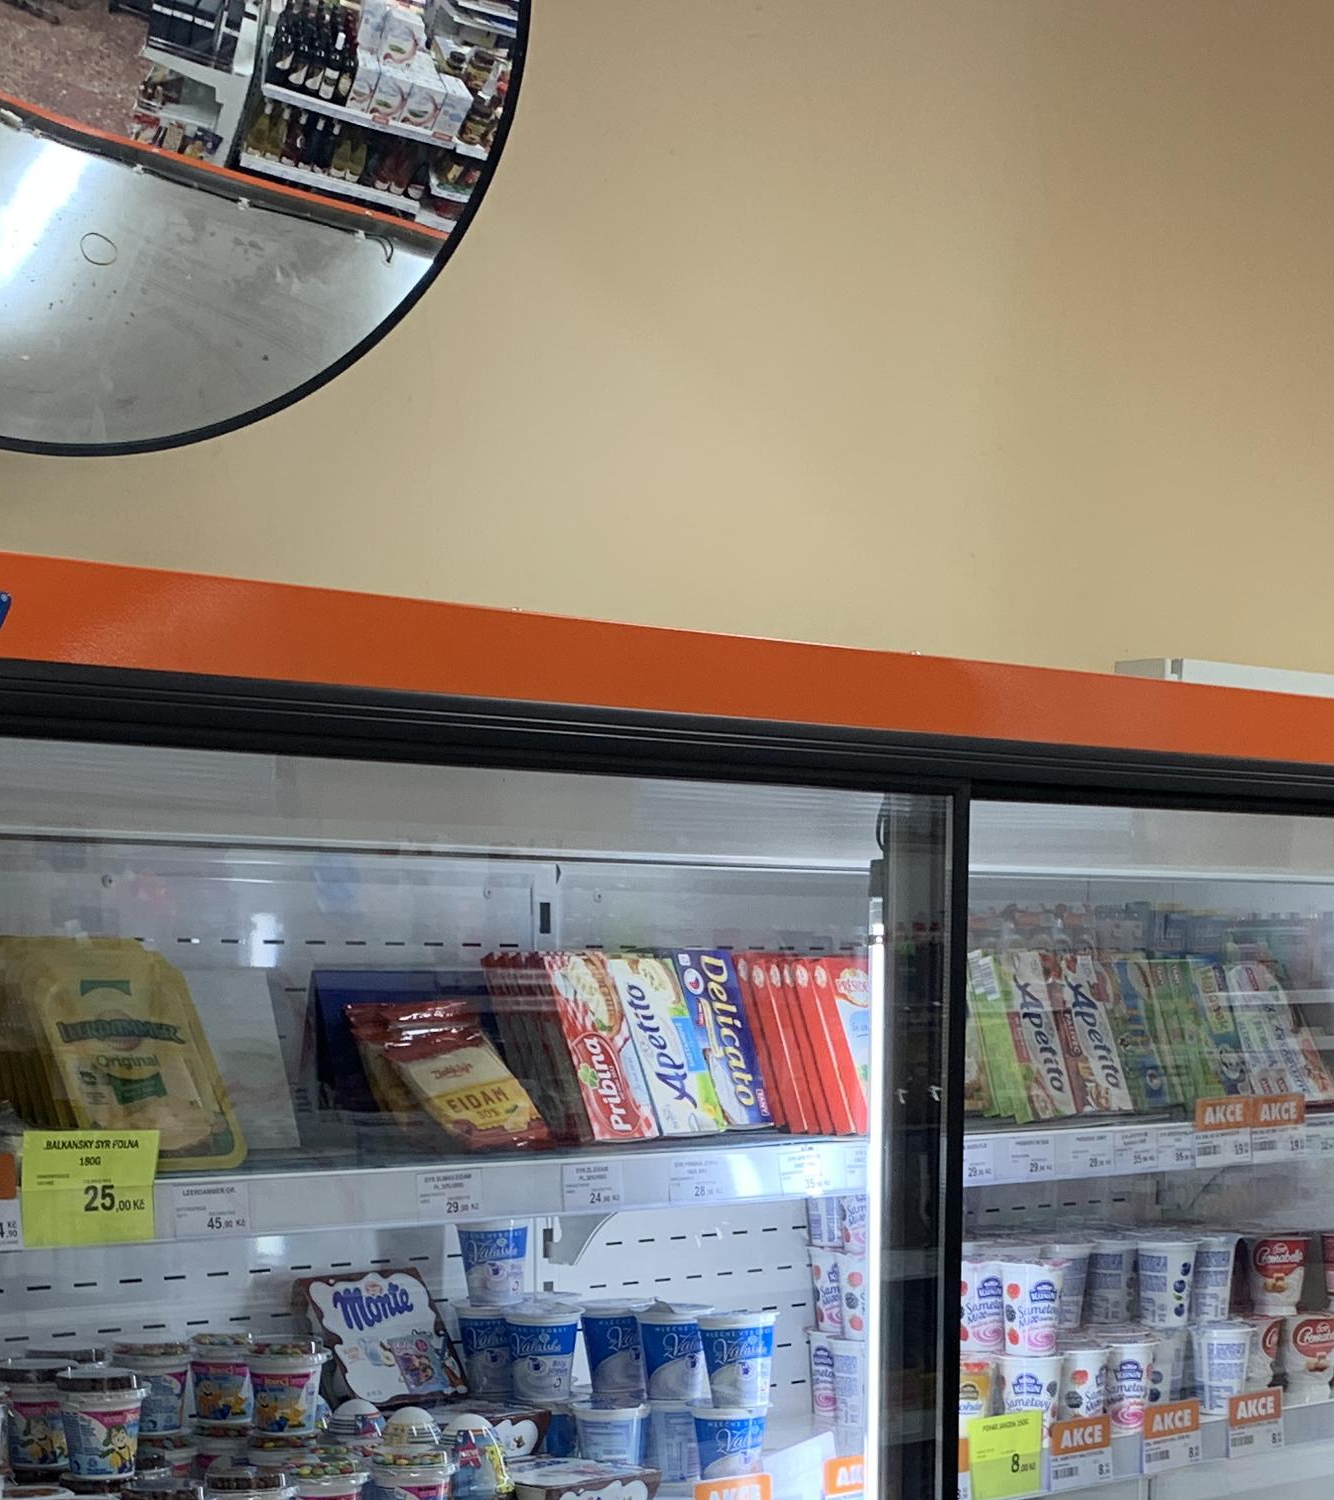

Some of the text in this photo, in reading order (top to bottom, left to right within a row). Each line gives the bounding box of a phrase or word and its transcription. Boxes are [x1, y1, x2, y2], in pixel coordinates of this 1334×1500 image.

[700, 954, 755, 1107] Delicato
[1014, 981, 1065, 1095] Apetito
[1068, 982, 1121, 1090] Apetito
[622, 982, 699, 1110] Apetito
[96, 1054, 160, 1071] Original
[575, 1037, 632, 1132] Pribina
[446, 1085, 509, 1114] EIDAM
[1259, 1101, 1298, 1122] AKCE
[1203, 1103, 1244, 1125] AKCE
[133, 1199, 145, 1210] Kč
[332, 1281, 414, 1332] Monte
[1152, 1409, 1192, 1432] AKCE
[1236, 1397, 1275, 1420] AKCE
[1060, 1425, 1102, 1449] AKCE
